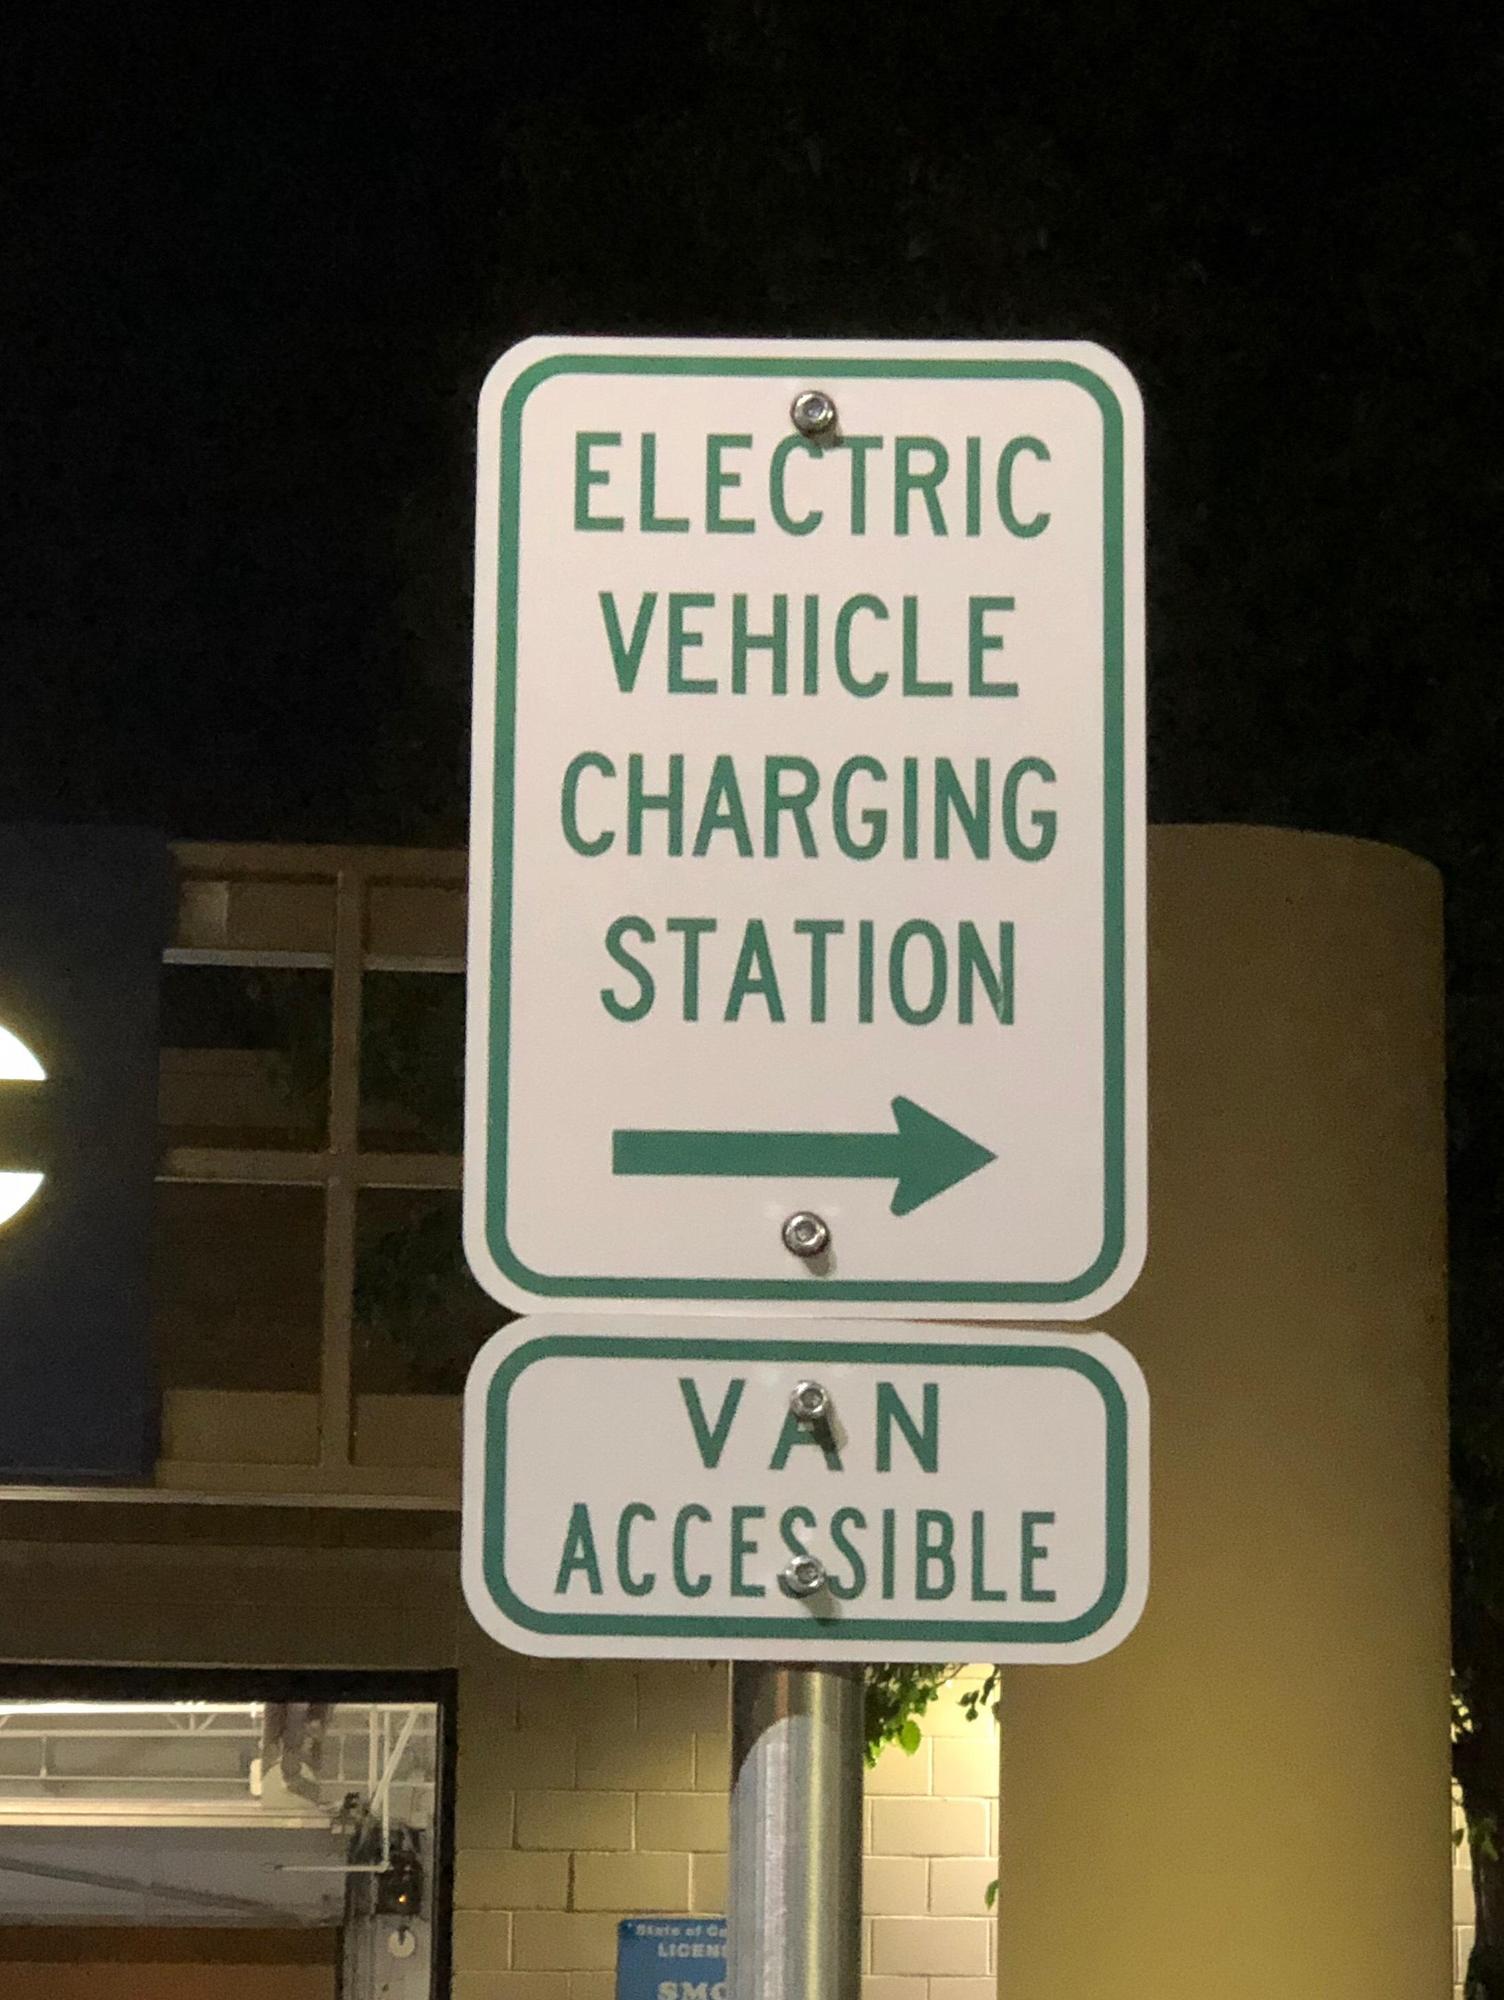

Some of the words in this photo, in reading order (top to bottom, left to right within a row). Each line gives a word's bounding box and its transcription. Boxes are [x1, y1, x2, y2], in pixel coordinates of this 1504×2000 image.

[575, 431, 1051, 538] ELECTRIC
[599, 592, 1019, 697] VEHICLE
[562, 751, 1057, 861] CHARGING
[601, 915, 1016, 1024] STATION
[679, 1378, 939, 1473] VAN
[555, 1503, 1056, 1603] ACCESSIBLE
[636, 1924, 681, 1937] State
[685, 1925, 702, 1937] of
